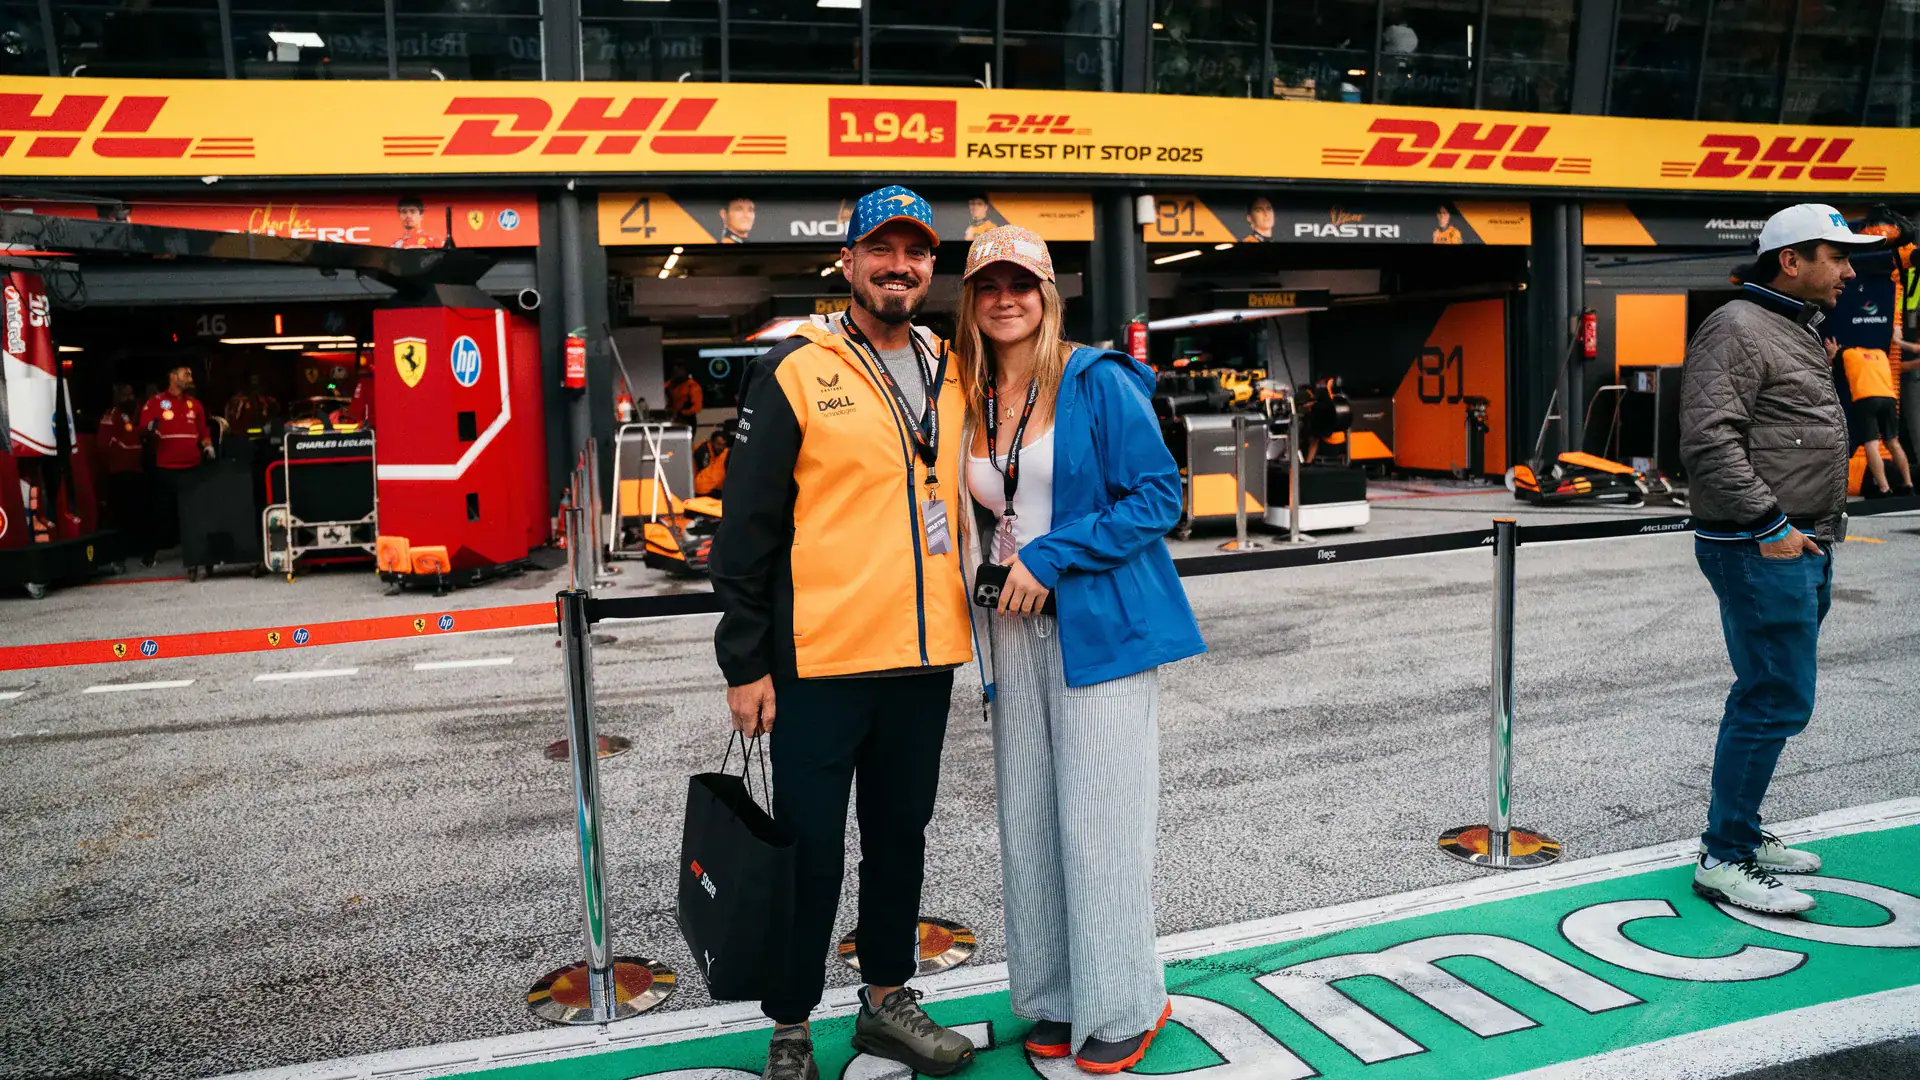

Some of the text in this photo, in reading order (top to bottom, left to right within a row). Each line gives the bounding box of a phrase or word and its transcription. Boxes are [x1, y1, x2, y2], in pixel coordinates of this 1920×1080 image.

[0, 93, 193, 158] HL
[440, 97, 736, 156] DHL
[985, 113, 1079, 135] DHL
[967, 143, 1204, 163] FASTEST PIT STOP 2025
[1360, 118, 1558, 172] DHL
[1692, 134, 1858, 181] DHL
[500, 210, 518, 230] hp
[620, 198, 656, 238] 4
[791, 220, 850, 236] NO
[1294, 223, 1400, 238] PIASTRI
[197, 314, 227, 335] 16
[456, 338, 477, 387] hp
[1418, 345, 1476, 404] 81
[817, 395, 855, 411] DELL
[296, 440, 337, 450] CHARLES
[1010, 427, 1023, 463] Experiences
[1640, 522, 1684, 533] McLaren
[440, 615, 454, 629] hp
[294, 629, 308, 643] hp
[142, 640, 157, 655] hp
